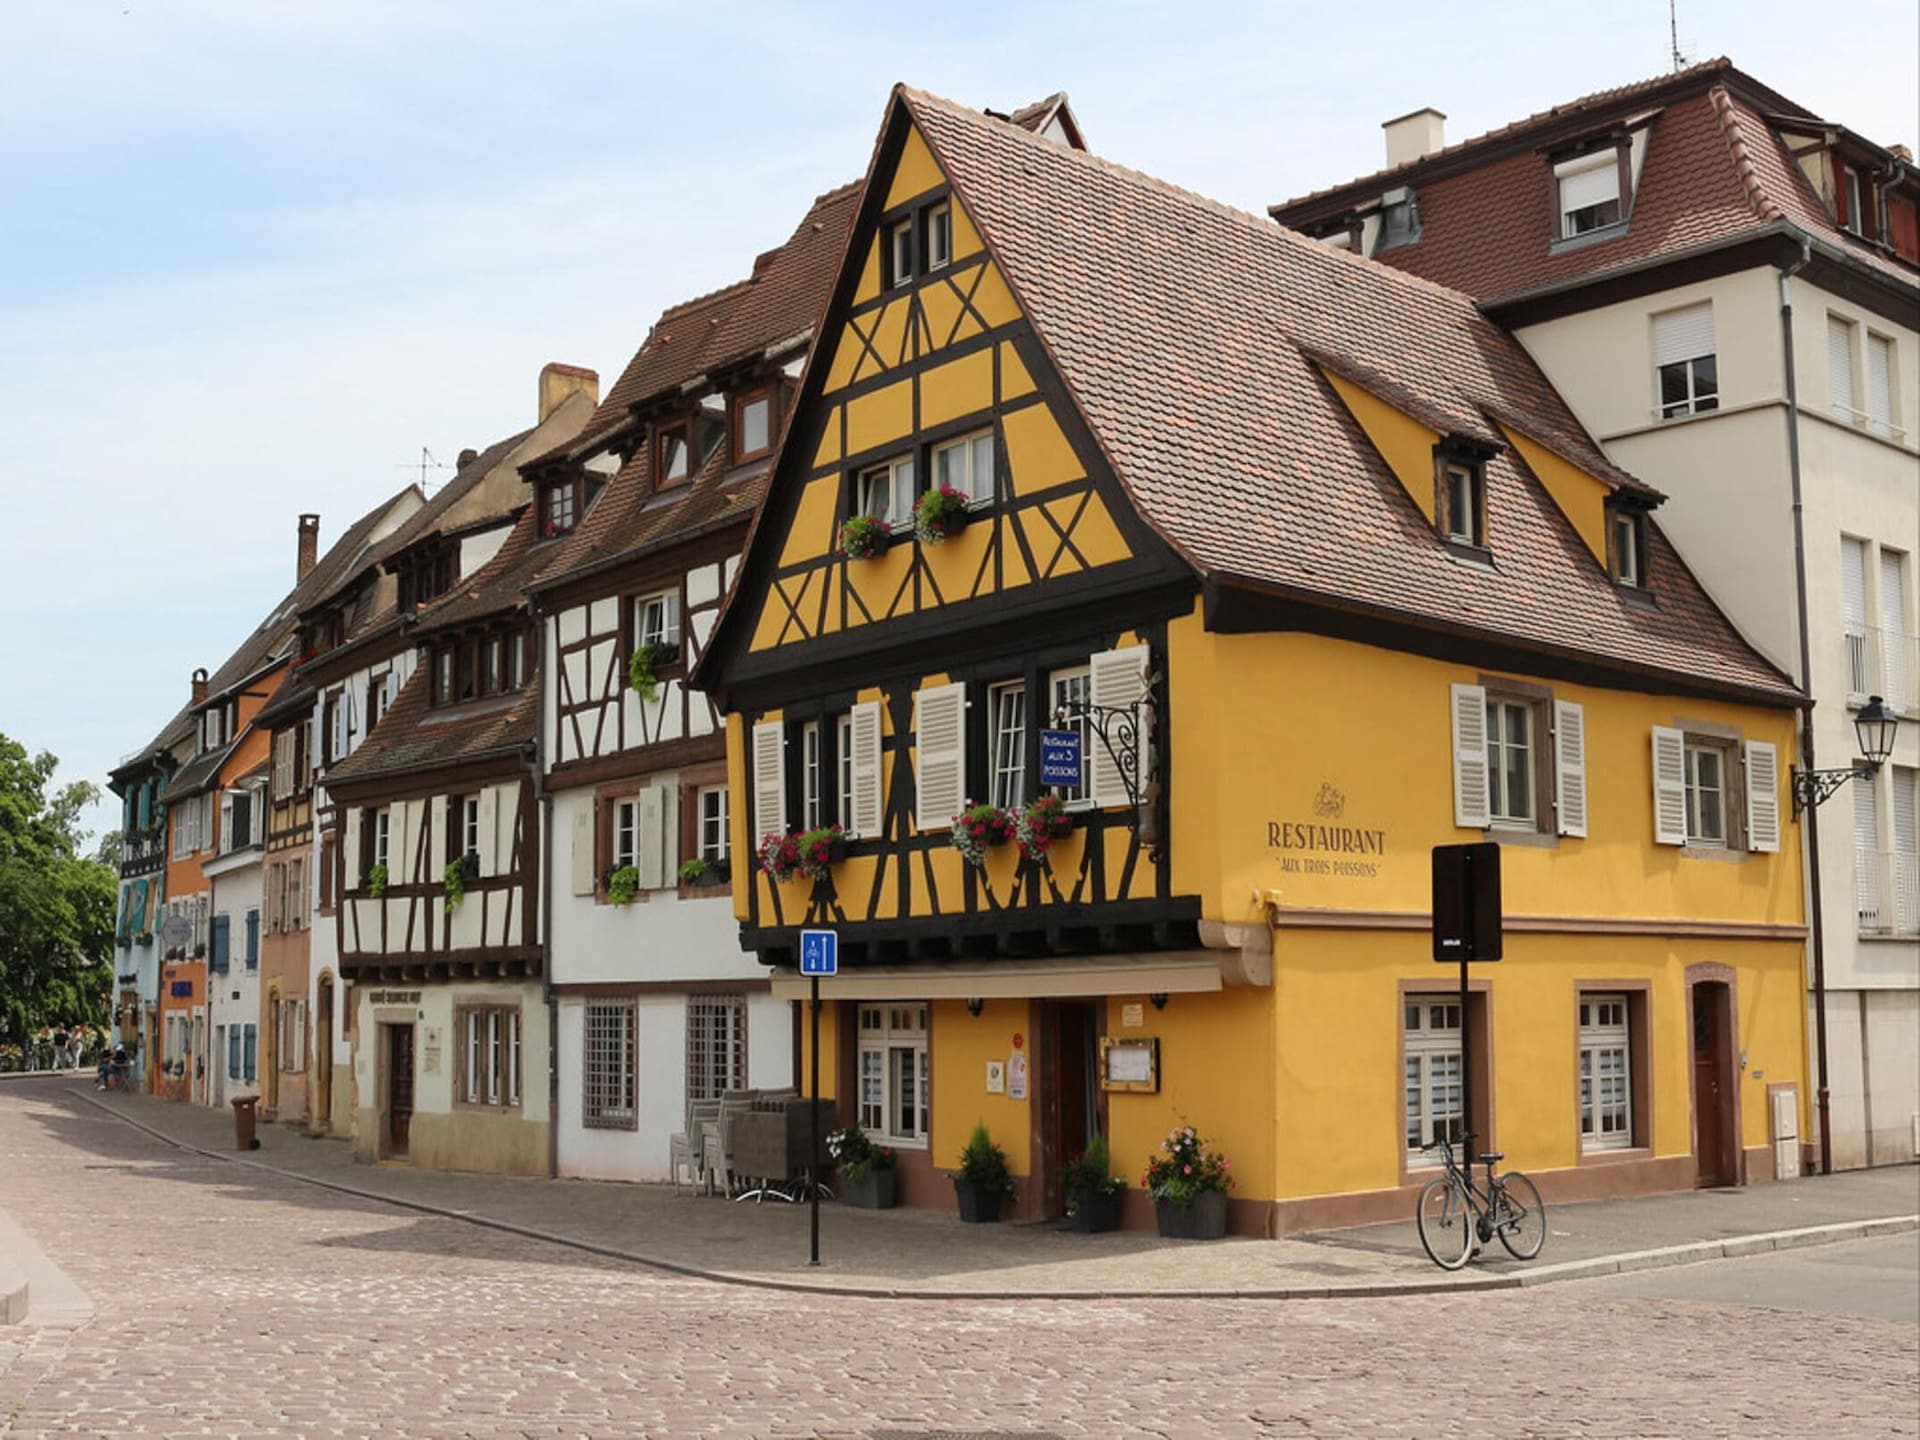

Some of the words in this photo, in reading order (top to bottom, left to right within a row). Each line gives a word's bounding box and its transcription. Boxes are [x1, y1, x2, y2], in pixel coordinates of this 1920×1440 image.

[1065, 749, 1074, 761] 3
[1267, 821, 1386, 856] RESTAURANT
[1304, 858, 1331, 875] TROIS
